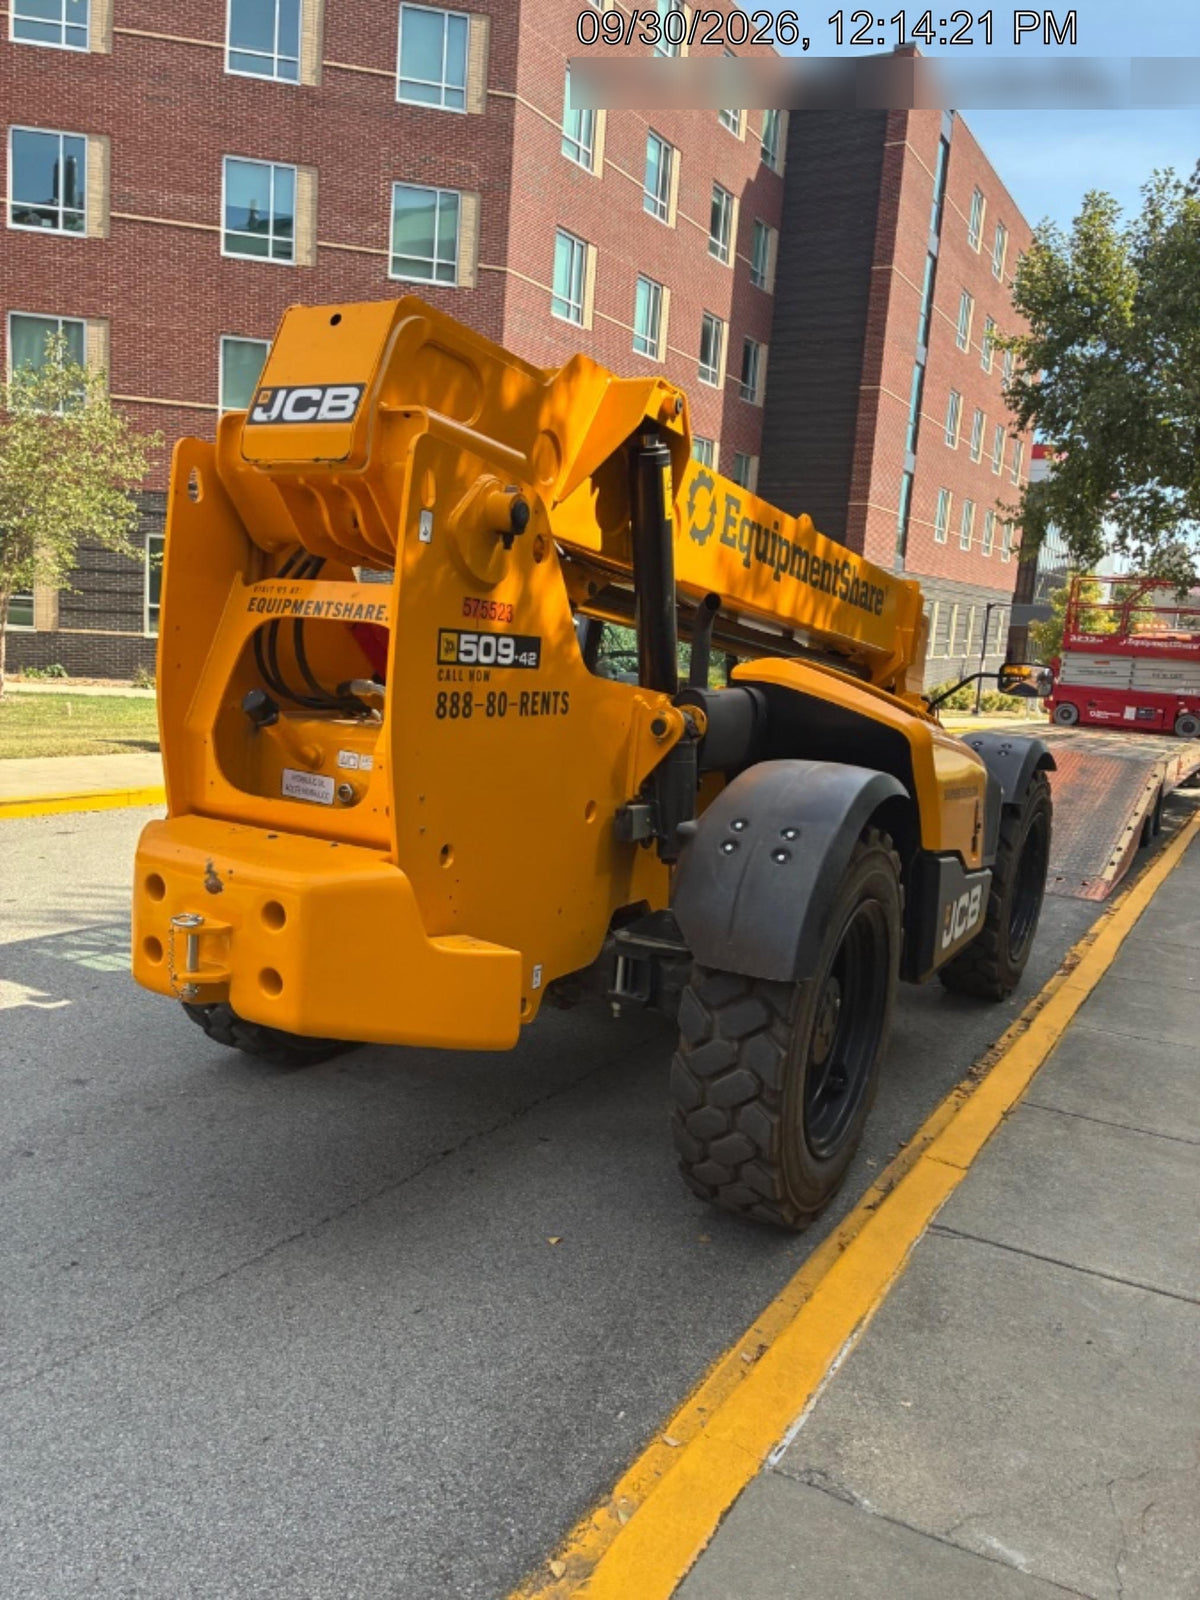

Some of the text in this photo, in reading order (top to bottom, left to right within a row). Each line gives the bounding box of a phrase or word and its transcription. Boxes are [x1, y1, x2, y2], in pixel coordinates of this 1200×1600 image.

[252, 386, 360, 422] JCB
[719, 492, 886, 616] EquipmentShare
[462, 597, 514, 624] 575523
[437, 669, 491, 682] CALL NOW
[436, 691, 570, 720] 888-80-RENTS
[942, 883, 982, 949] JCB
